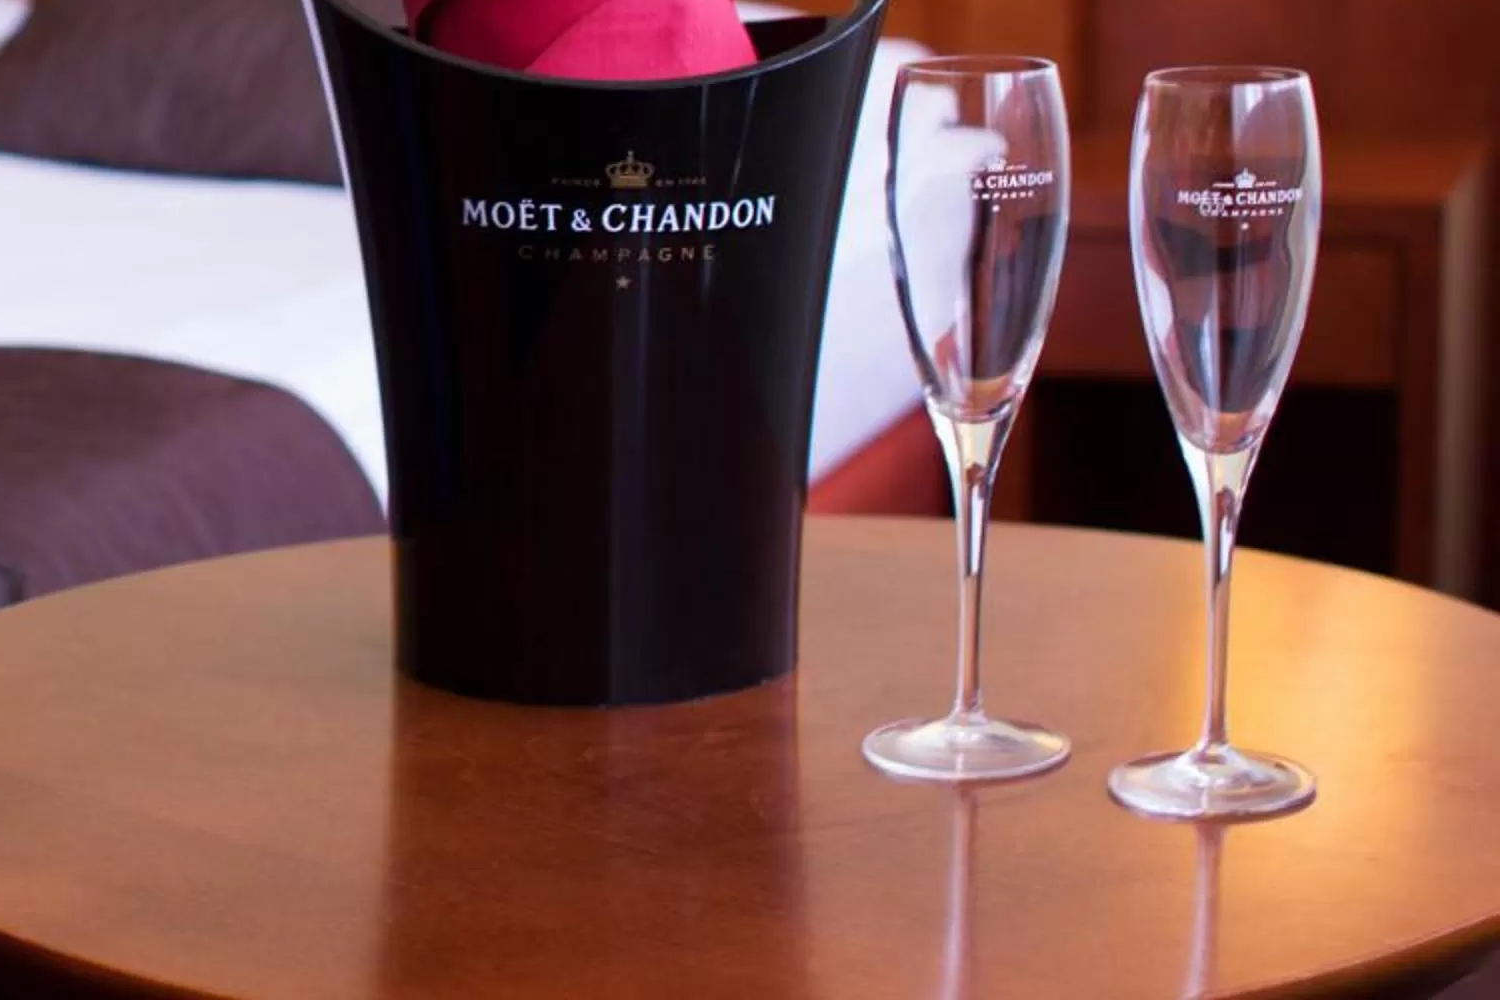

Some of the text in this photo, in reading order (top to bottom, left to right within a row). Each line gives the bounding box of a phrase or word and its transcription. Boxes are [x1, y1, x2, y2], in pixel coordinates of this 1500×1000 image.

[987, 171, 1053, 189] CHANDON
[1236, 188, 1303, 205] CHANDON
[462, 195, 776, 233] MOËT & CHANDON
[518, 244, 717, 262] CHAMPAGNE
